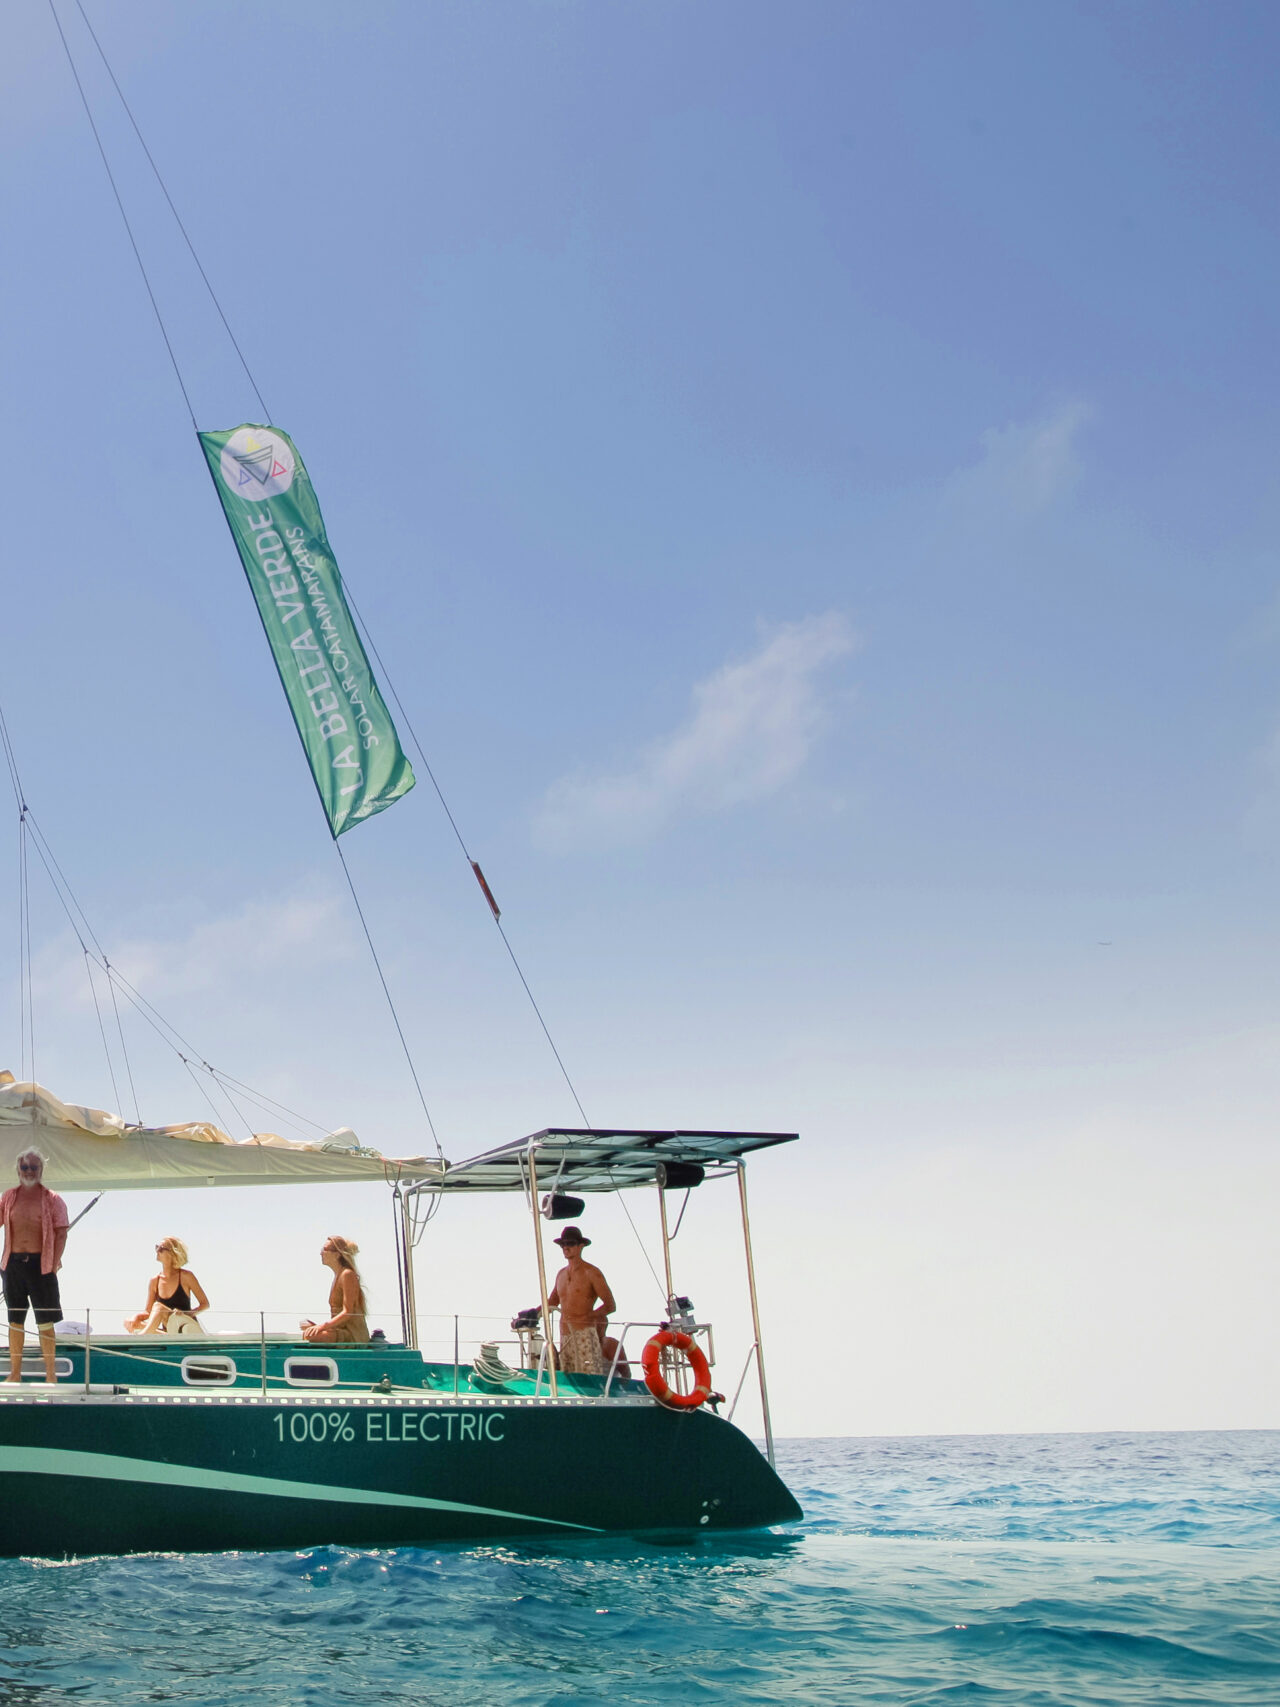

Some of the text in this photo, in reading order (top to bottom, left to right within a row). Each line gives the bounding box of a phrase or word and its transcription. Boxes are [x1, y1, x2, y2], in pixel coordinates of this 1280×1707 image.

[248, 507, 364, 796] LA BELLA VERDE
[285, 526, 349, 673] CATAMARANS
[343, 679, 379, 750] SOLAR
[273, 1412, 505, 1442] 100% ELECTRIC
